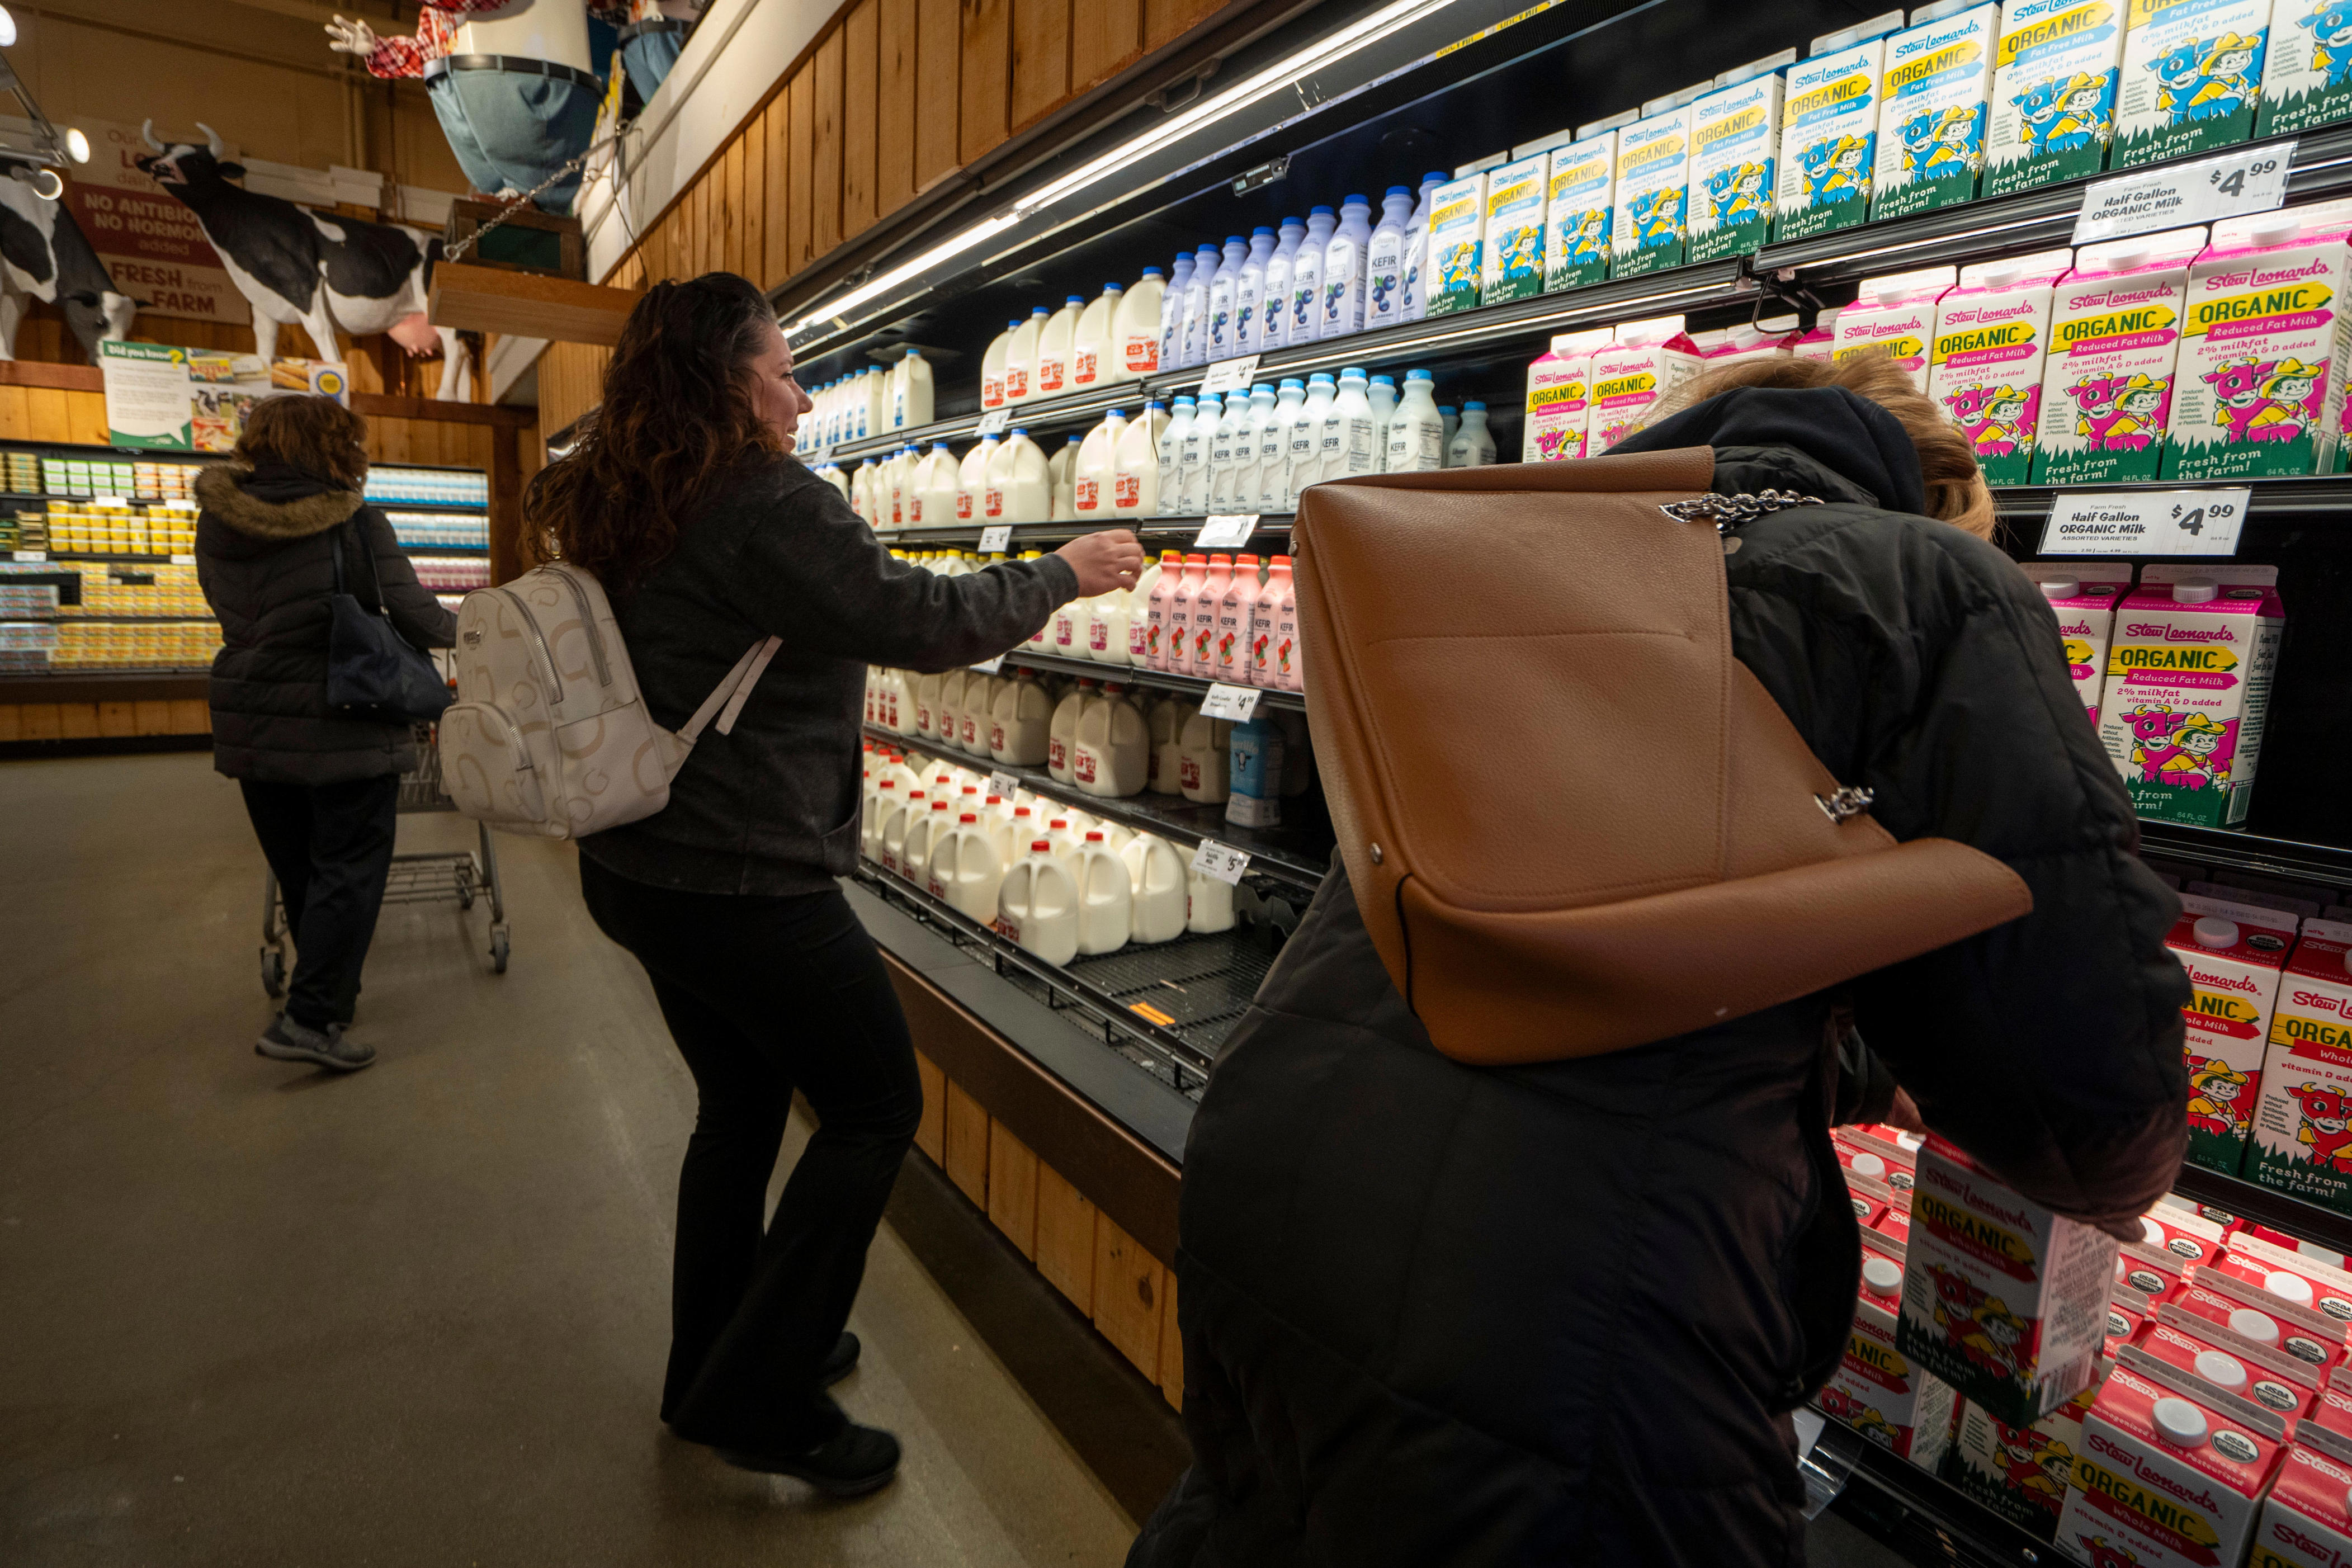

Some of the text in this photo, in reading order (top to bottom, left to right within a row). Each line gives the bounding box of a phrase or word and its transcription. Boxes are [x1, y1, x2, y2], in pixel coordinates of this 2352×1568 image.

[2014, 0, 2049, 21] Stew
[2008, 10, 2096, 53] ORGANIC
[2164, 15, 2210, 37] milkfat
[1896, 20, 1980, 58] Stew Leonard's
[2030, 33, 2094, 58] Fat Free Milk
[1795, 55, 1869, 89] Stew Leonard's
[1891, 48, 1966, 87] ORGANIC
[1699, 88, 1764, 120] Stew Leonard's
[1792, 81, 1858, 115] ORGANIC
[2271, 99, 2317, 127] Fresh
[1625, 118, 1682, 146] Stew Leonard's
[1697, 112, 1754, 145] ORGANIC
[1623, 140, 1674, 169] ORGANIC
[2123, 126, 2203, 162] Fresh from
[2150, 140, 2192, 162] farm!
[1494, 176, 1510, 188] Stew
[1554, 164, 1598, 191] ORGANIC
[1992, 159, 2060, 189] Fresh from
[1435, 192, 1450, 205] Stew
[1492, 184, 1532, 208] ORGANIC
[2104, 194, 2131, 207] Half
[2133, 187, 2176, 202] Gallon
[86, 194, 198, 223] NO ANTIBIO
[1433, 202, 1469, 224] ORGANIC
[2091, 197, 2184, 221] ORGANIC Milk
[2136, 209, 2175, 220] VARIETIES
[94, 214, 209, 242] NO HORMON
[1782, 209, 1833, 233] Fresh from
[139, 239, 189, 255] added
[1372, 256, 1396, 268] KEFIR
[1617, 252, 1656, 272] Fresh from
[112, 263, 223, 292] FRESH from
[1294, 271, 1314, 282] KEFIR
[1548, 269, 1581, 287] Fresh from
[2205, 257, 2329, 291] Stew Leonard's
[1265, 281, 1283, 292] KEFIR
[1486, 283, 1517, 300] Fresh from
[2069, 281, 2173, 310] Stew Leonard's
[152, 290, 216, 315] FARM
[1496, 292, 1513, 305] farm!
[2199, 289, 2310, 324] ORGANIC
[1945, 300, 2033, 325] Stew Leonard's
[1844, 315, 1921, 339] Stew Leonard's
[2063, 310, 2157, 341] ORGANIC
[2214, 315, 2317, 337] Reduced Fat Milk
[1940, 327, 2019, 354] ORGANIC
[107, 344, 126, 356] Did
[128, 348, 145, 360] you
[1951, 353, 1987, 365] Reduced
[2006, 347, 2026, 357] Milk
[1535, 367, 1584, 385] Stew Leonard's
[1533, 386, 1576, 405] ORGANIC
[1597, 377, 1646, 398] ORGANIC
[1262, 445, 1277, 454] KEFIR
[1292, 440, 1310, 450] KEFIR
[1323, 438, 1339, 448] KEFIR
[1391, 442, 1406, 451] KEFIR
[2046, 458, 2117, 476] Fresh from
[2178, 450, 2261, 470] Fresh from
[2178, 461, 2250, 480] the farm!
[2071, 512, 2097, 522] Half
[2099, 512, 2140, 522] Gallon
[2060, 524, 2146, 534] ORGANIC Milk
[1149, 611, 1161, 620] KEFIR
[1173, 612, 1186, 621] KEFIR
[1197, 615, 1212, 623] KEFIR
[1221, 617, 1236, 626] KEFIR
[1255, 619, 1271, 628] KEFIR
[2126, 623, 2165, 640] Stew
[2165, 624, 2235, 643] Leonard's
[2120, 649, 2218, 668] ORGANIC
[2132, 673, 2223, 686] Reduced Fat Milk
[2138, 689, 2180, 697] milkfat
[2293, 966, 2349, 981] Homogenized
[2293, 990, 2340, 1011] Stew
[2204, 1019, 2229, 1033] Milk
[2281, 1062, 2321, 1076] vitamin
[2258, 1173, 2336, 1198] the farm!
[2259, 1161, 2348, 1189] Fresh from
[1921, 1196, 2016, 1255] ORGANIC
[2088, 1434, 2218, 1514] Stew Leonard's
[2080, 1463, 2197, 1536] ORGANIC
